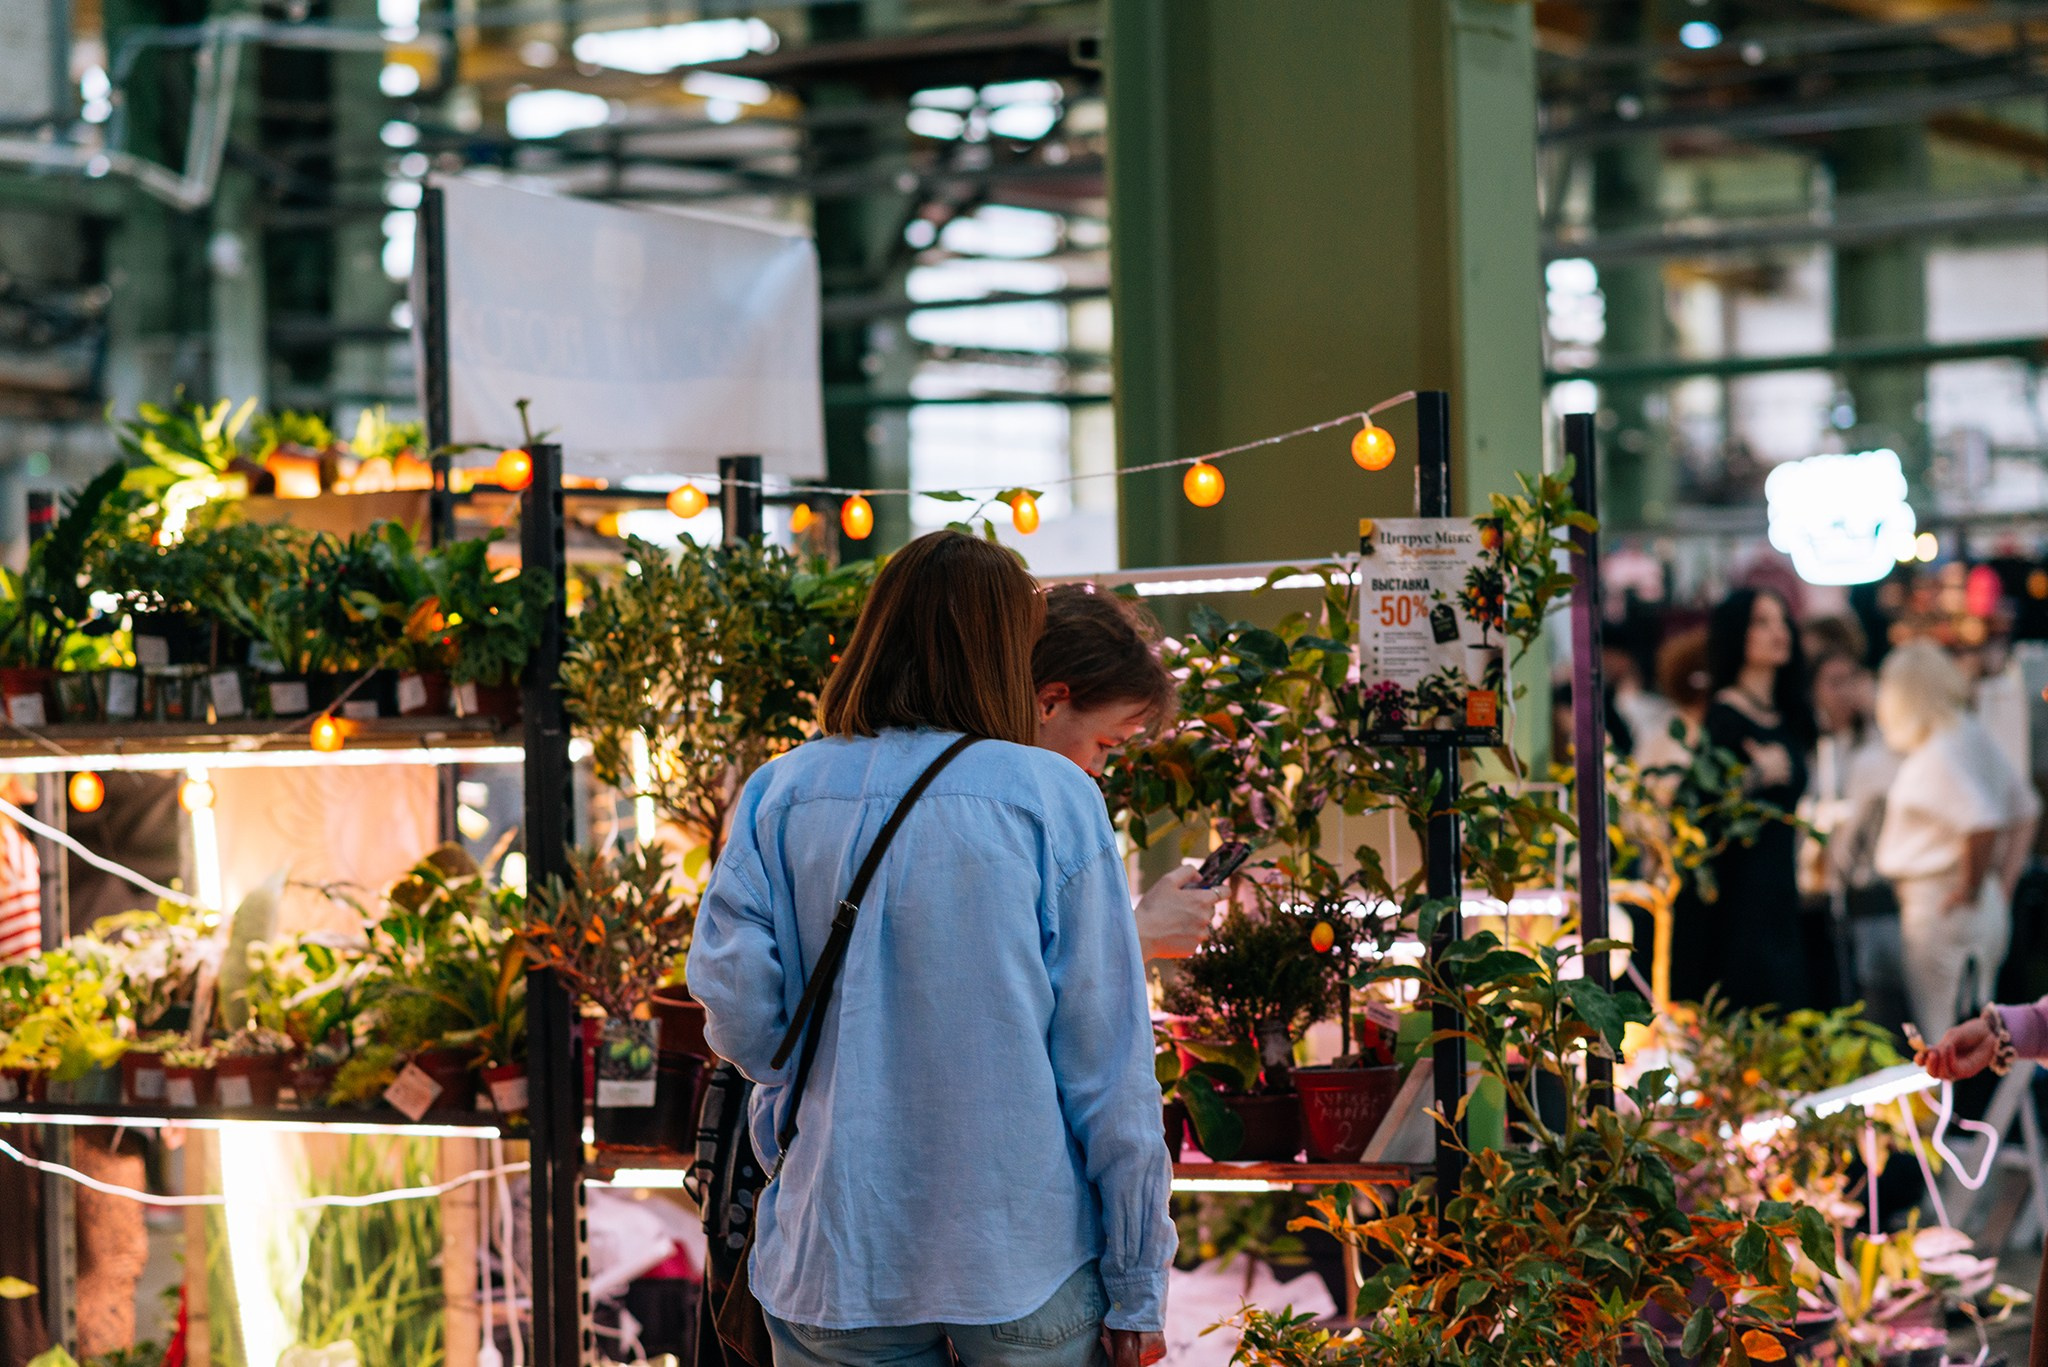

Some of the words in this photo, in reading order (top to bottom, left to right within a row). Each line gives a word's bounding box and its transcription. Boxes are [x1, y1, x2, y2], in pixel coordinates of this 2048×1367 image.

[1380, 531, 1432, 548] Цитрус
[1435, 531, 1473, 545] Микс
[1371, 578, 1430, 591] ВЫСТАВКА
[1370, 595, 1429, 627] -50%
[1332, 1120, 1359, 1154] 2
